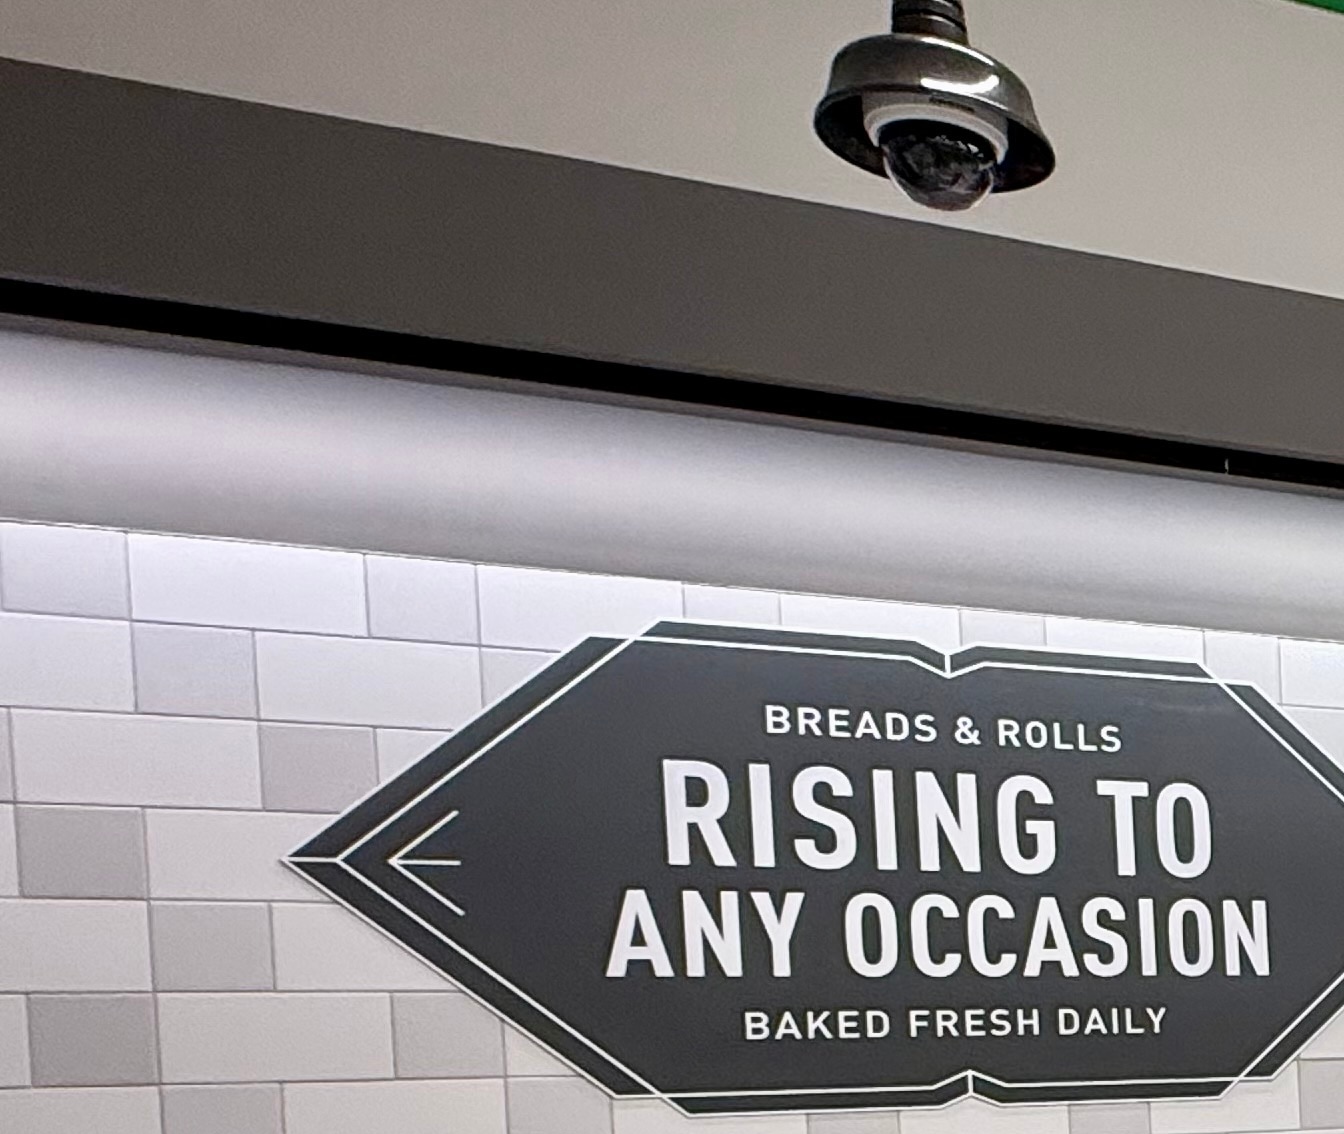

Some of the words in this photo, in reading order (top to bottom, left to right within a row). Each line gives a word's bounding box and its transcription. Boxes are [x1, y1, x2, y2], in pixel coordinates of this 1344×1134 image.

[764, 703, 938, 746] BREADS
[953, 713, 982, 747] &
[997, 716, 1123, 755] ROLLS
[660, 757, 1058, 876] RISING
[1095, 777, 1215, 880] TO
[604, 887, 806, 980] ANY
[843, 896, 1272, 980] OCCASION
[743, 1009, 892, 1043] BAKED
[909, 1007, 1042, 1041] FRESH
[1056, 1006, 1168, 1040] DAILY
